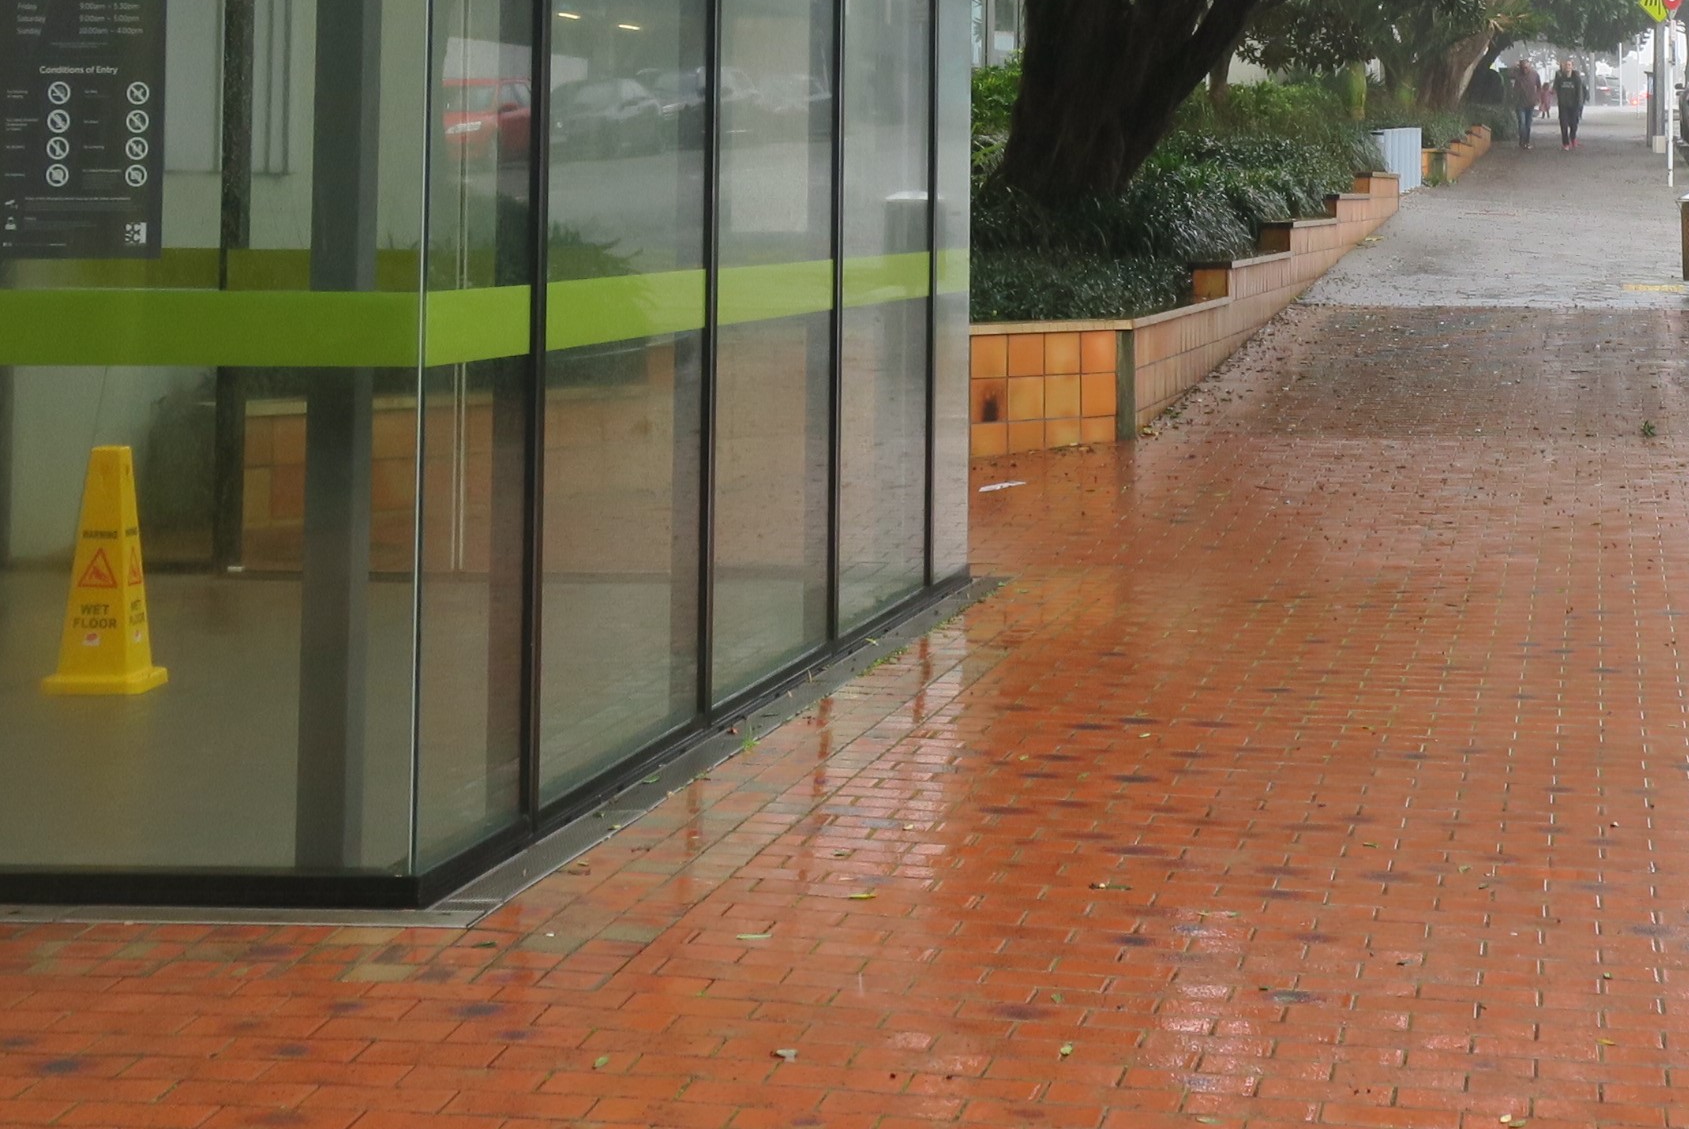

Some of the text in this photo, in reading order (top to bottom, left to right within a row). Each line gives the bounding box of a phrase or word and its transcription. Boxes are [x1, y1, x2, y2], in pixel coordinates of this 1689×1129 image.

[39, 65, 119, 75] Conditions of Entry
[80, 603, 109, 616] WET
[72, 617, 118, 630] FLOOR
